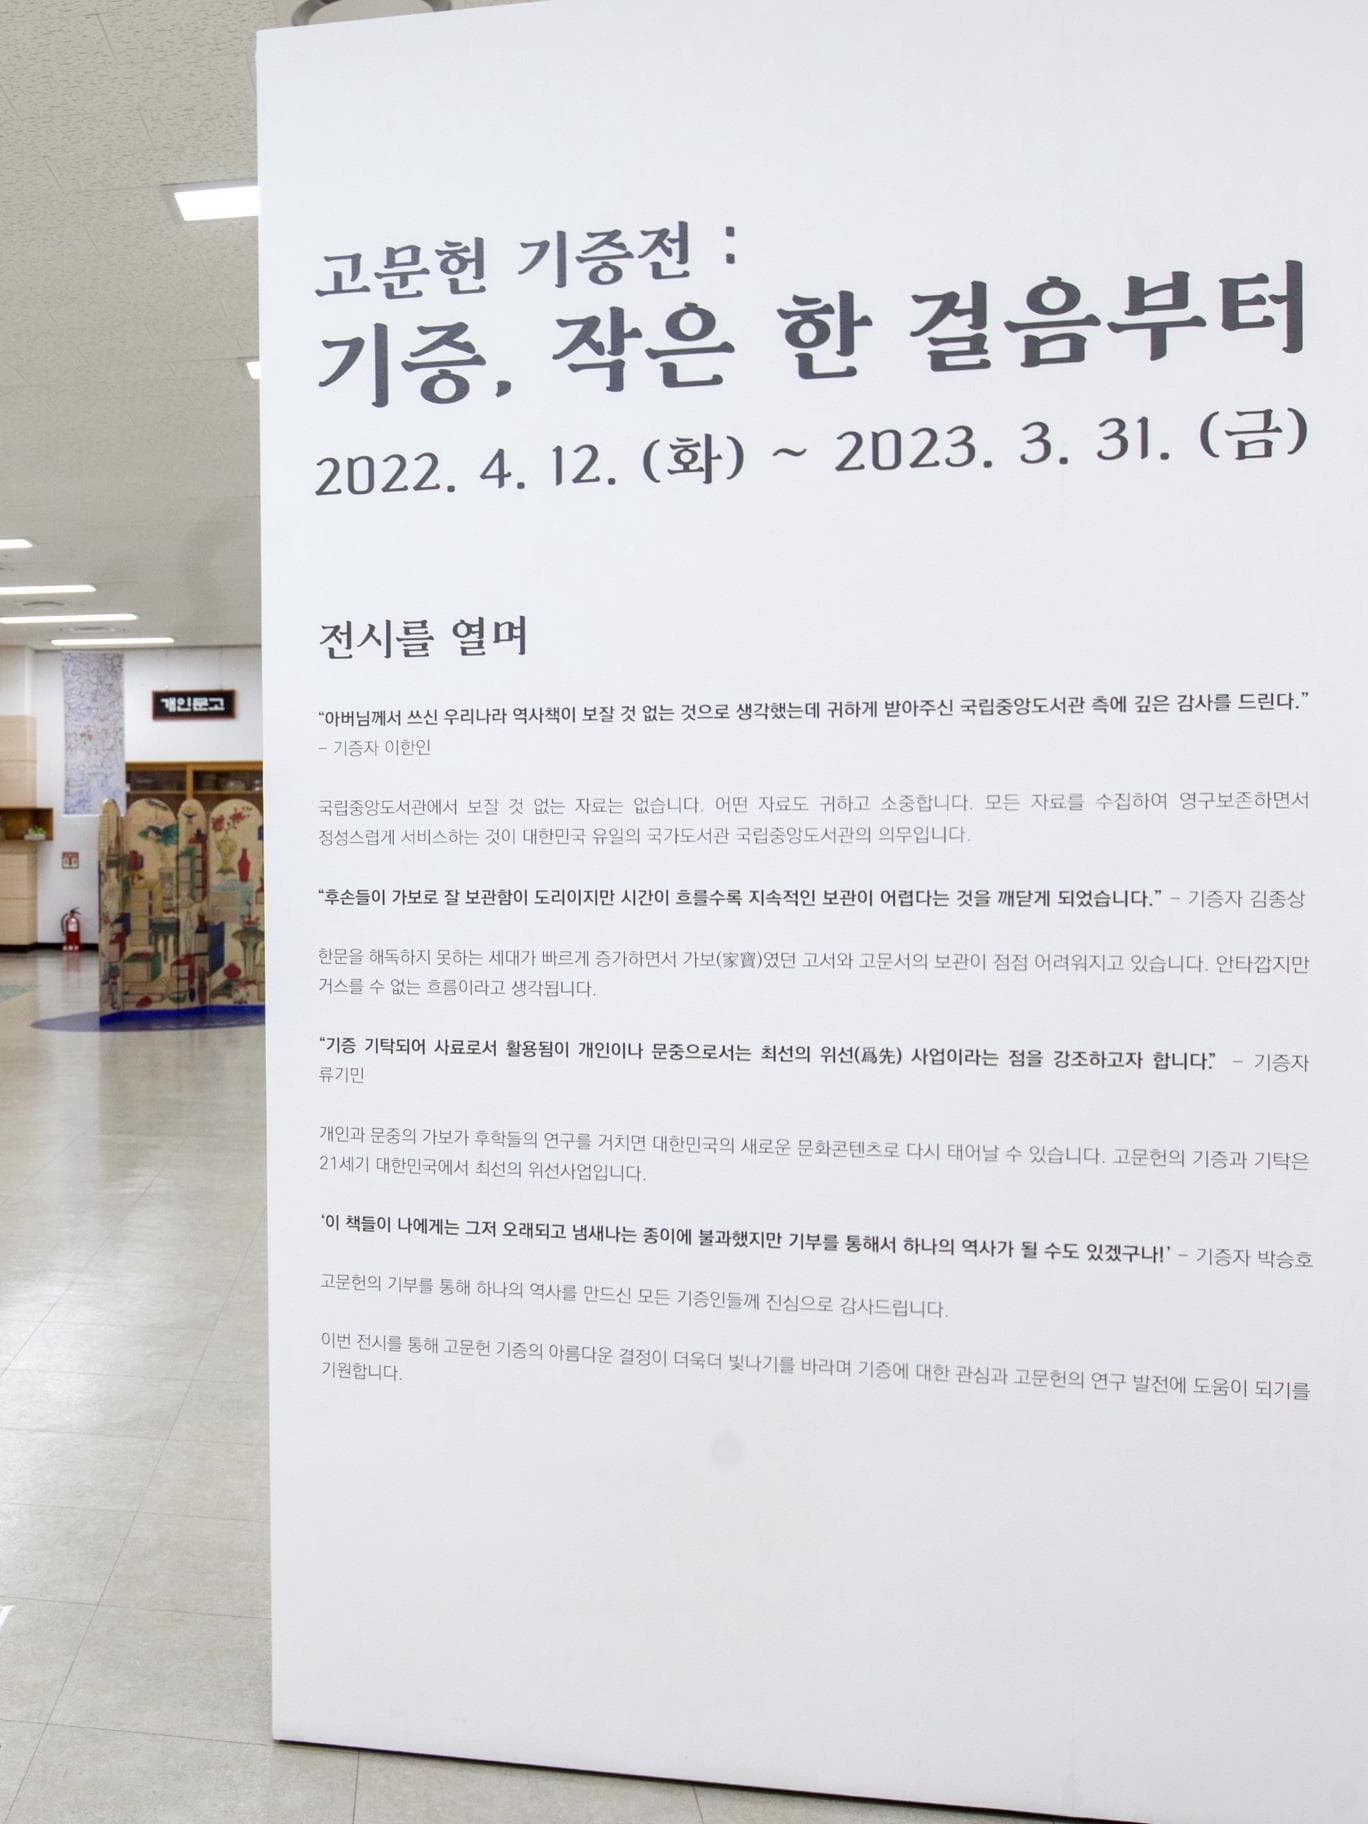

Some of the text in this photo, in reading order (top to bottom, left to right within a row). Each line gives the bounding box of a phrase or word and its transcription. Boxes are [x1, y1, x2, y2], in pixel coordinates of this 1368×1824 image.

[316, 221, 689, 299] 고문헌 기증전
[319, 260, 1303, 409] 기증, 작은 한 걸음부터
[316, 453, 455, 495] 2022.
[480, 449, 524, 489] 4.
[553, 445, 615, 485] 12.
[644, 434, 743, 484] (화)
[836, 426, 992, 471] 2023.
[1021, 422, 1068, 464] 3.
[1097, 417, 1169, 460] 31.
[1200, 408, 1307, 460] (금)
[320, 616, 525, 659] 전시를 열며
[160, 697, 225, 712] 개인문고
[407, 708, 439, 726] 쓰신
[443, 707, 508, 726] 우리나라
[512, 706, 576, 725] 역사책이
[581, 705, 616, 723] 보잘
[620, 704, 636, 723] 것
[642, 704, 676, 723] 없는
[680, 703, 731, 722] 것으로
[735, 701, 820, 721] 생각했는데
[826, 700, 878, 719] 귀하게
[884, 698, 953, 718] 받아주신
[959, 695, 1086, 717] 국립중앙도서관
[1091, 695, 1127, 715] 측에
[1134, 694, 1171, 714] 깊은
[1176, 693, 1232, 713] 감사를
[333, 737, 431, 758] 기증자 이한인
[318, 790, 1309, 817] 국립중앙도서관에서 보잘 것 없는 자료는 없습니다. 어떤 자료도 귀하고 소중합니다. 모든 자료를 수집하여 영구보존하면서
[392, 888, 439, 906] 가보로
[443, 888, 461, 906] 잘
[464, 888, 528, 907] 보관함이
[533, 888, 616, 907] 도리이지만
[620, 888, 670, 907] 시간이
[675, 889, 743, 907] 흐를수록
[748, 888, 816, 908] 지속적인
[821, 889, 873, 908] 보관이
[880, 889, 950, 908] 어렵다는
[956, 889, 992, 908] 것을
[997, 889, 1051, 908] 깨닫게
[1188, 889, 1244, 909] 기증자
[1250, 889, 1306, 909] 김종상
[318, 947, 365, 966] 한문을
[369, 948, 431, 966] 해독하지
[436, 948, 484, 967] 못하는
[488, 949, 537, 967] 세대가
[542, 949, 590, 968] 빠르게
[594, 950, 677, 969] 증가하면서
[801, 951, 854, 970] 고서와
[858, 952, 928, 971] 고문서의
[934, 953, 986, 971] 보관이
[993, 953, 1028, 972] 점점
[1034, 953, 1125, 973] 어려워지고
[1130, 954, 1209, 974] 있습니다.
[1216, 954, 1311, 975] 안타깝지만
[318, 977, 597, 999] 거스를 수 없는 흐름이라고 생각됩니다.
[364, 1037, 426, 1056] 기탁되어
[433, 1038, 497, 1057] 사료로서
[505, 1039, 569, 1059] 활용됨이
[578, 1041, 644, 1060] 개인이나
[651, 1042, 753, 1062] 문중으로서는
[760, 1044, 811, 1064] 최선의
[911, 1047, 1000, 1067] 사업이라는
[1008, 1049, 1044, 1068] 점을
[1053, 1049, 1144, 1070] 강조하고자
[1254, 1053, 1310, 1073] 기증자
[318, 1066, 365, 1084] 류기민
[319, 1155, 646, 1183] 21세기 대한민국에서 최선의 위선사업입니다.
[345, 1214, 391, 1233] 책들이
[397, 1217, 460, 1236] 나에게는
[464, 1220, 497, 1238] 그저
[501, 1221, 567, 1241] 오래되고
[572, 1224, 638, 1244] 냄새나는
[642, 1226, 692, 1246] 종이에
[697, 1228, 783, 1249] 불과했지만
[788, 1232, 840, 1252] 기부를
[844, 1234, 896, 1254] 통해서
[903, 1236, 955, 1257] 하나의
[961, 1238, 1015, 1259] 역사가
[1020, 1240, 1038, 1260] 될
[1043, 1242, 1080, 1260] 수도
[1196, 1247, 1251, 1267] 기증자
[1258, 1250, 1313, 1269] 박승호
[321, 1331, 1311, 1401] 이번 전시를 통해 고문헌 기증의 아름다운 결정이 더욱더 빛나기를 바라며 기증에 대한 관심과 고문헌의 연구 발전에 도움이 되기를
[322, 1361, 403, 1382] 기원합니다.
